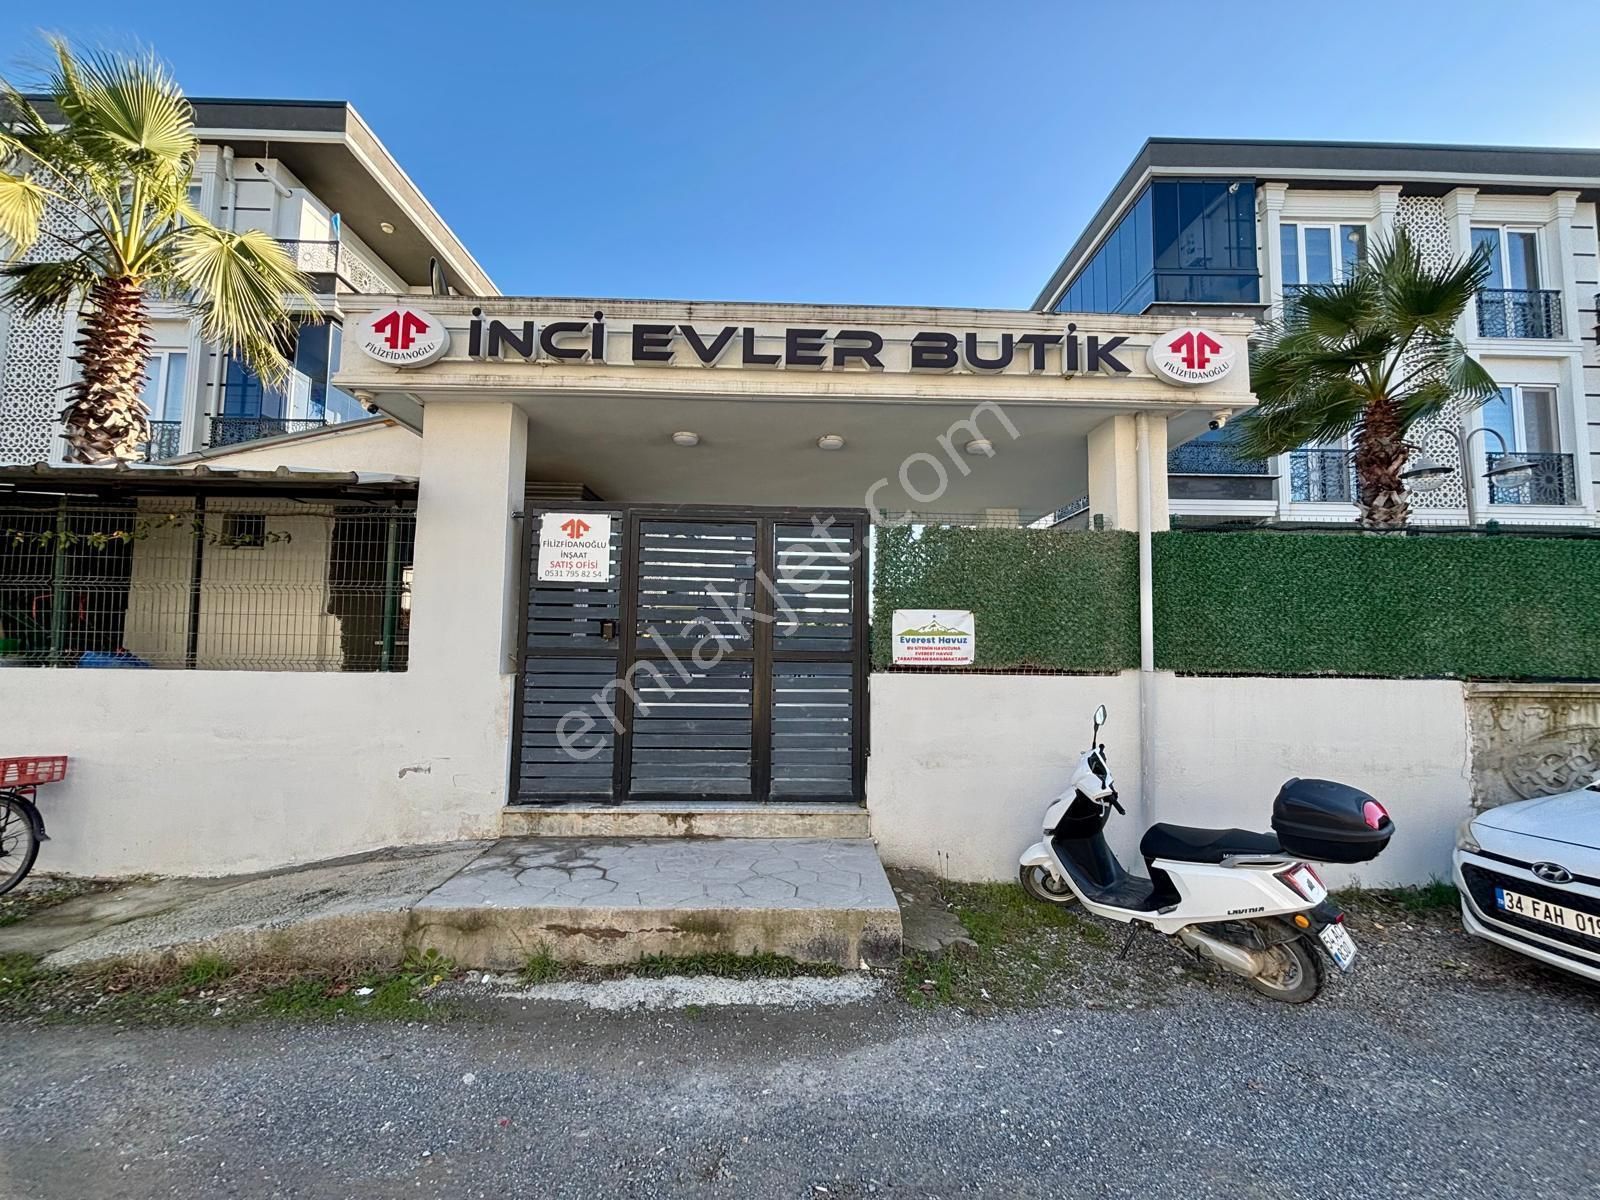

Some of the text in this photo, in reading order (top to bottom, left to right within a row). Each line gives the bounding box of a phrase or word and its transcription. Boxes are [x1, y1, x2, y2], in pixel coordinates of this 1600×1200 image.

[468, 307, 1132, 372] İNCİ EVLER BUTİK
[365, 342, 435, 360] FİLİZFİDANOĞLU
[1163, 361, 1230, 379] FİLİZFİDANOĞLU
[542, 538, 607, 549] FİLİZFİDANOĞLU
[560, 550, 588, 559] İNŞAAT
[550, 560, 598, 570] SATIŞ OFİSİ
[544, 569, 563, 577] 0531
[900, 636, 968, 644] Everest Havuz
[1505, 892, 1524, 912] 34
[1531, 900, 1565, 925] FAH
